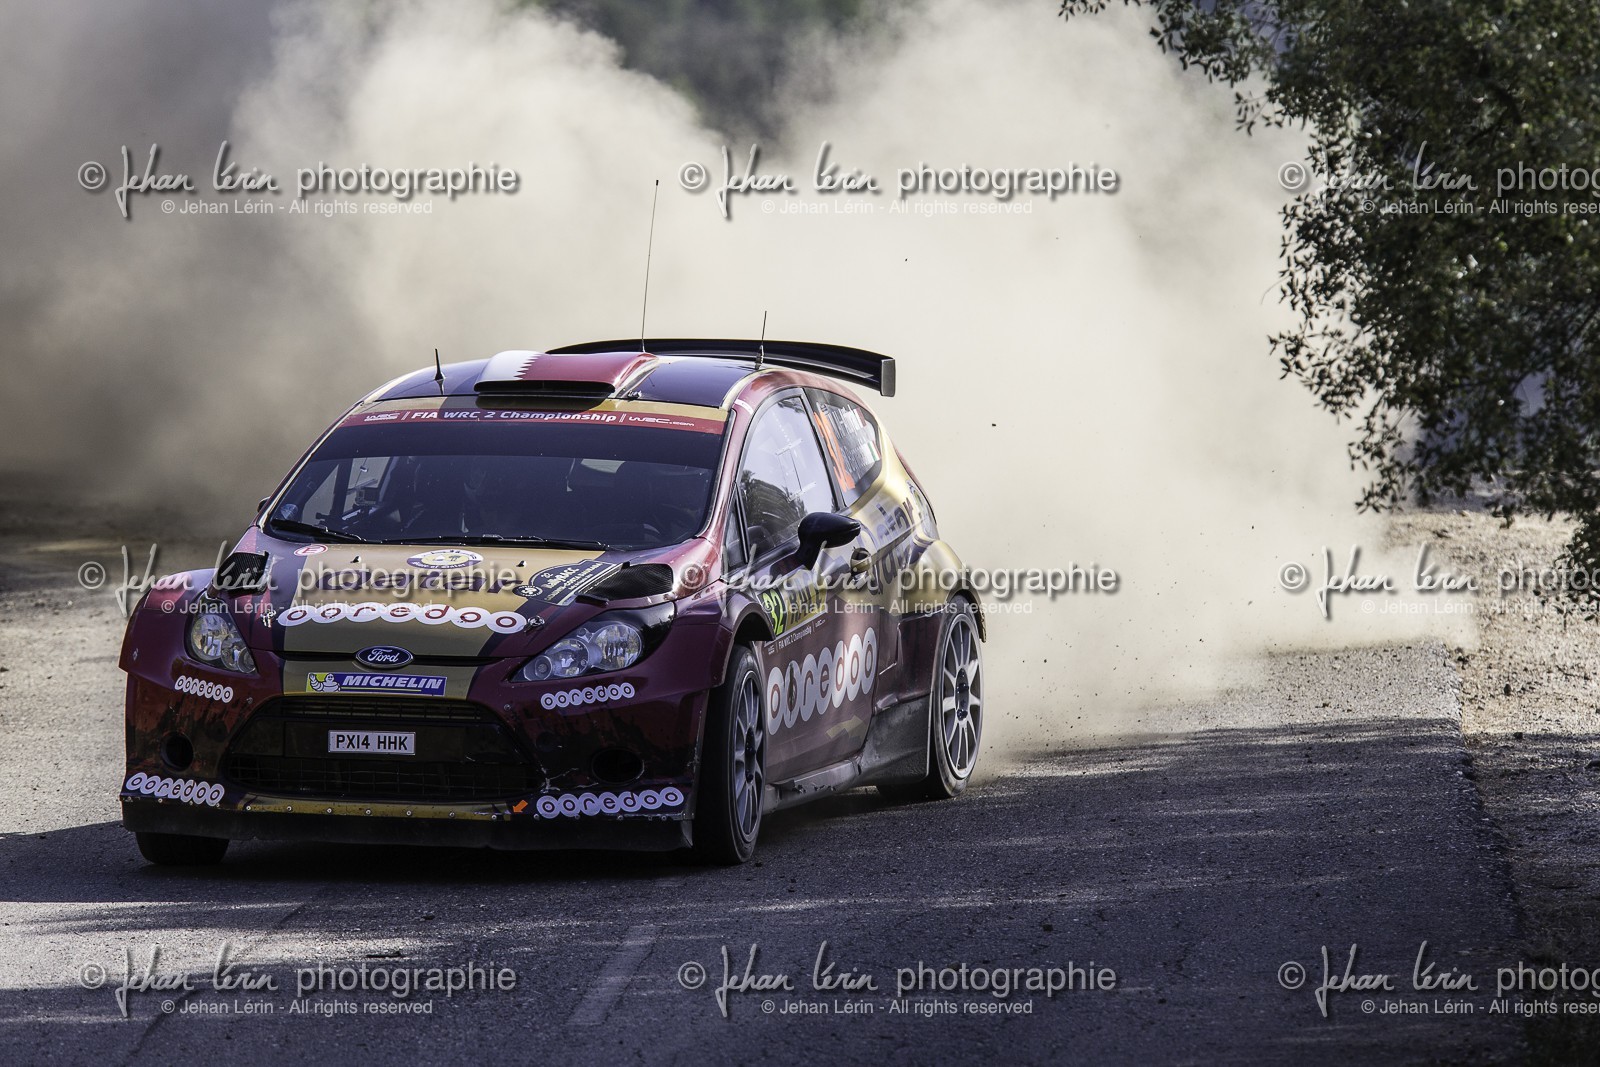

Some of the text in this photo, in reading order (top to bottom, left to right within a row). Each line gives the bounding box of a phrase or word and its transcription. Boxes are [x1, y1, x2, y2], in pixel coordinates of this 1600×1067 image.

[411, 411, 438, 419] FIA
[443, 411, 480, 419] WRC
[484, 411, 495, 419] 2
[500, 411, 616, 422] Championship
[283, 604, 521, 630] ooredoo
[367, 648, 399, 663] Ford
[176, 677, 232, 701] ooredoo
[342, 675, 443, 690] MICHELIN
[769, 636, 875, 726] ooredoo
[543, 684, 633, 708] ooredoo
[336, 735, 408, 750] PX14 HHK
[129, 775, 222, 803] ooredoo
[540, 789, 681, 815] ooredoo
